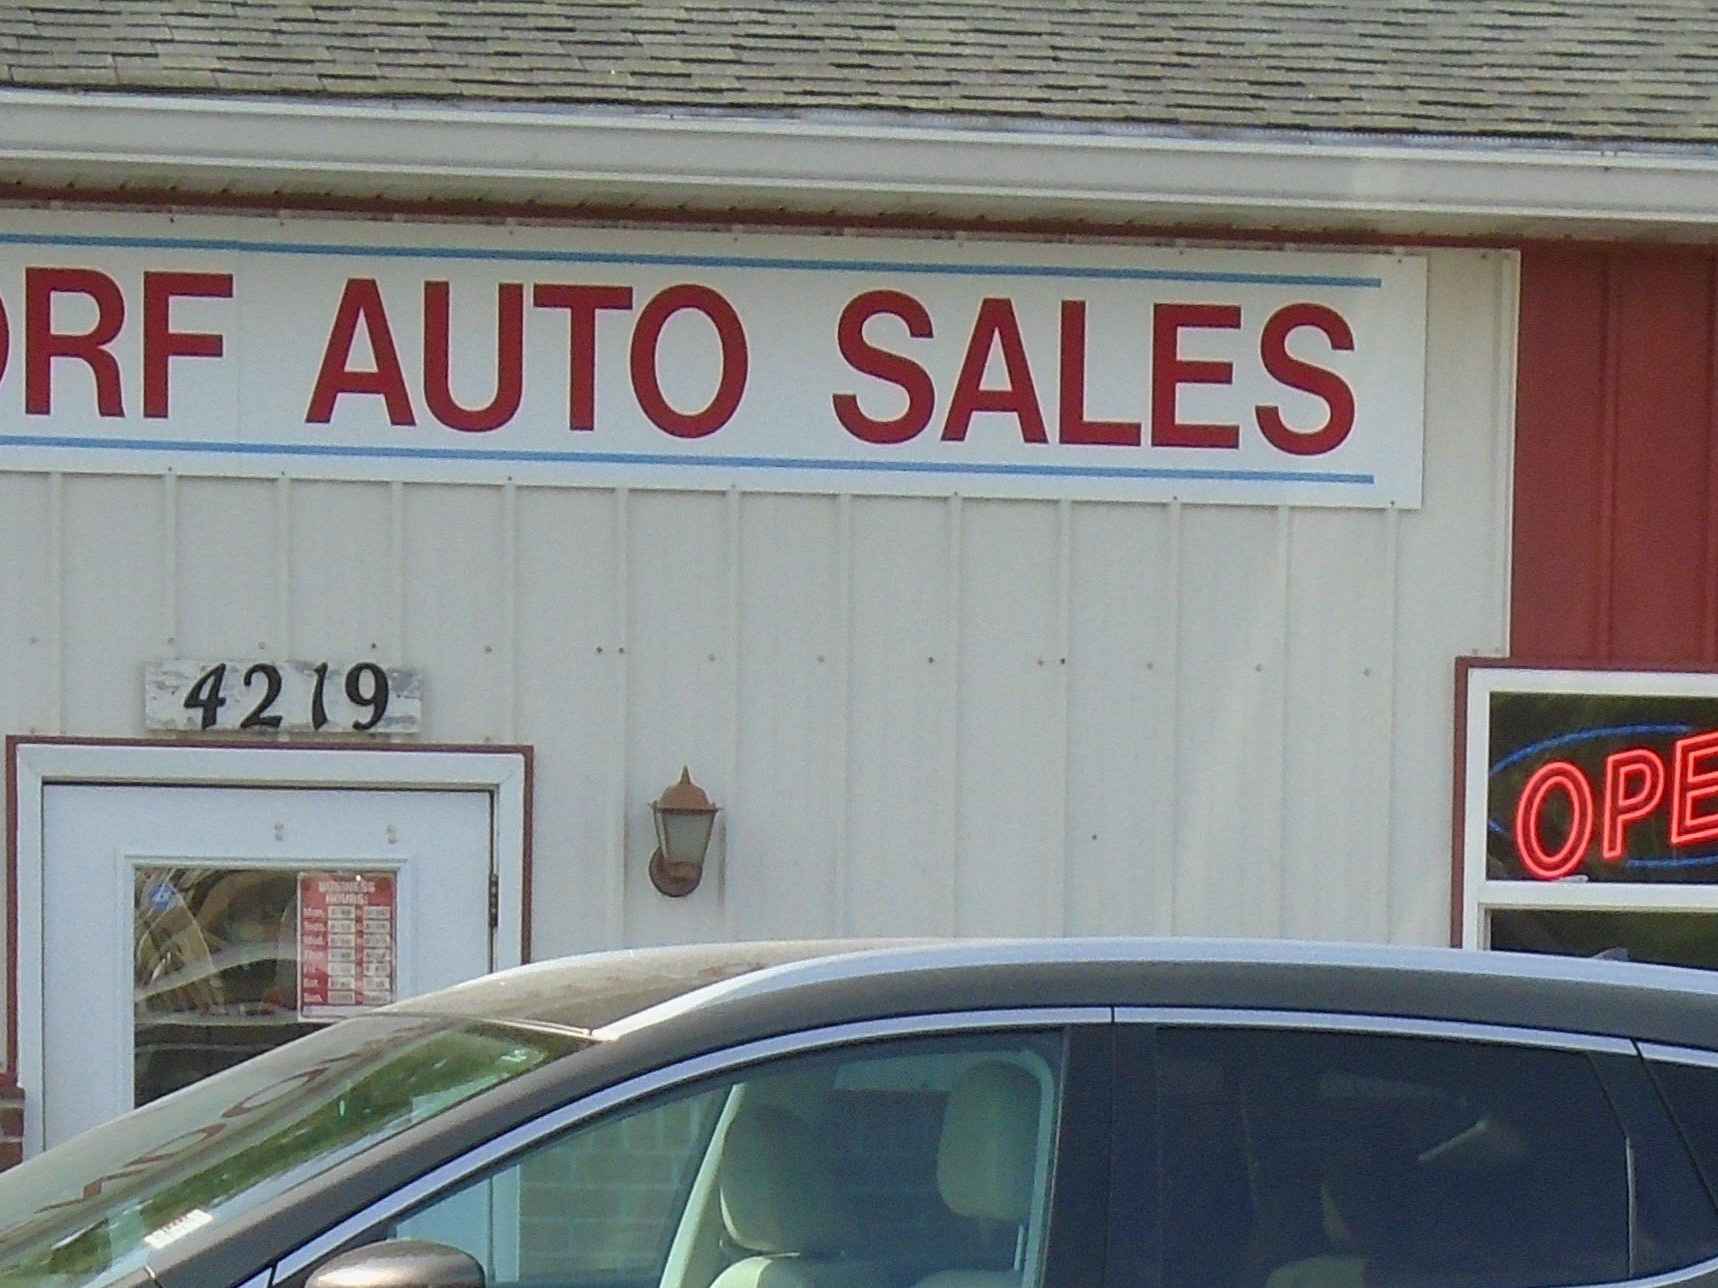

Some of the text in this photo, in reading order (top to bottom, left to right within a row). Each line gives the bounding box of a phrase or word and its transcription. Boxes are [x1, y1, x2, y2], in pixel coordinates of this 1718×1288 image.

[304, 277, 750, 440] AUTO
[831, 289, 1357, 457] SALES
[182, 662, 390, 731] 4219
